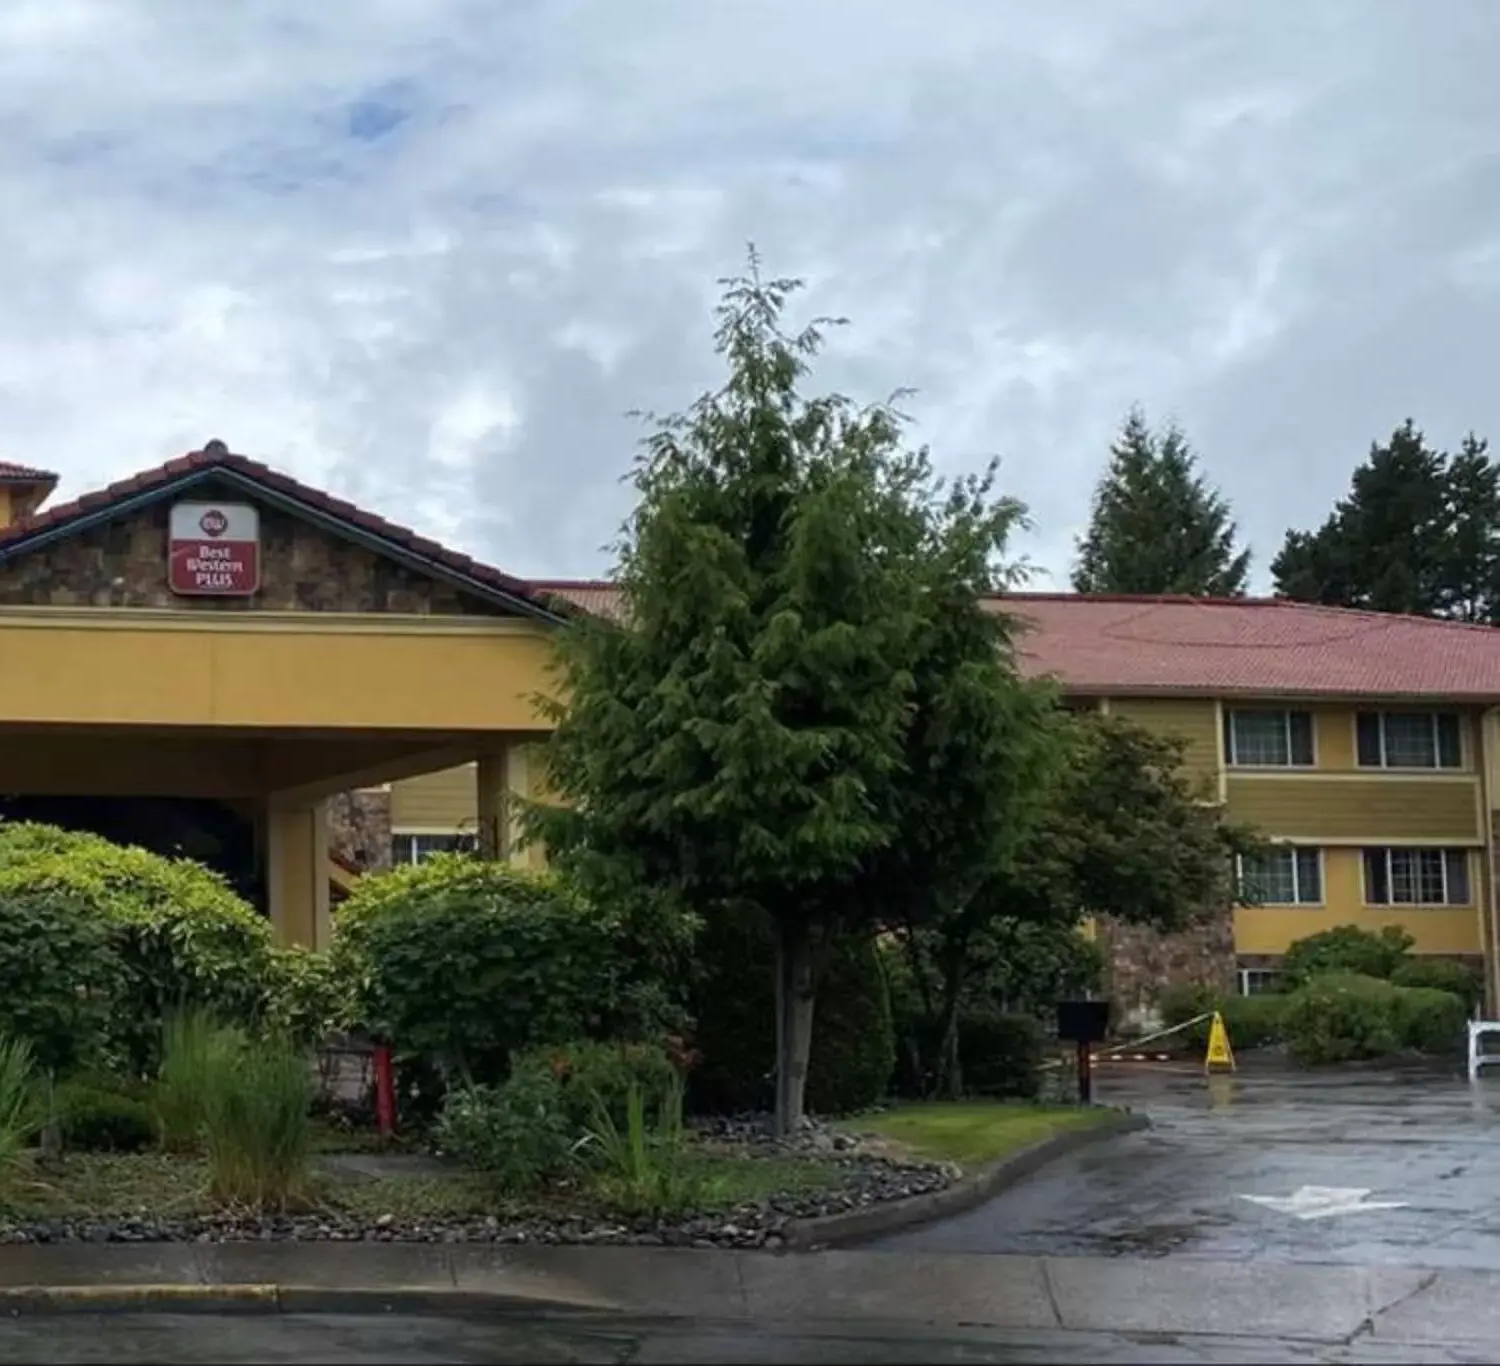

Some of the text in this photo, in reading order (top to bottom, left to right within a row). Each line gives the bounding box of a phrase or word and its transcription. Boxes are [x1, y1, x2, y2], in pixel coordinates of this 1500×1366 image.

[200, 545, 231, 558] Best
[186, 558, 243, 572] Western
[196, 572, 233, 586] PLUS
